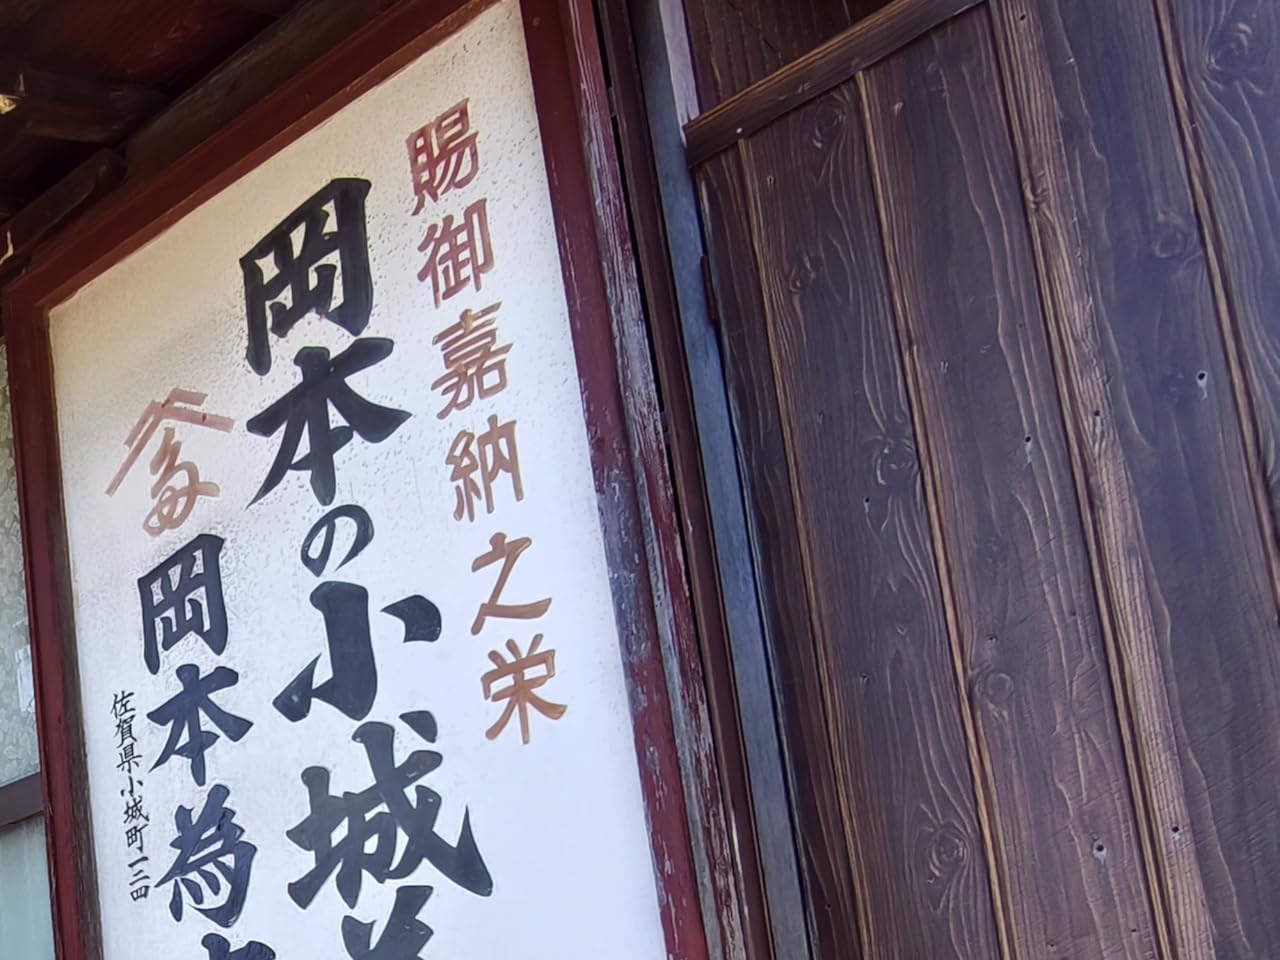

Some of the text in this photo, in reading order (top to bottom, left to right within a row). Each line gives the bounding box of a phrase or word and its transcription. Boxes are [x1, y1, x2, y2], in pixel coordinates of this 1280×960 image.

[407, 98, 567, 745] 賜御嘉納之栄
